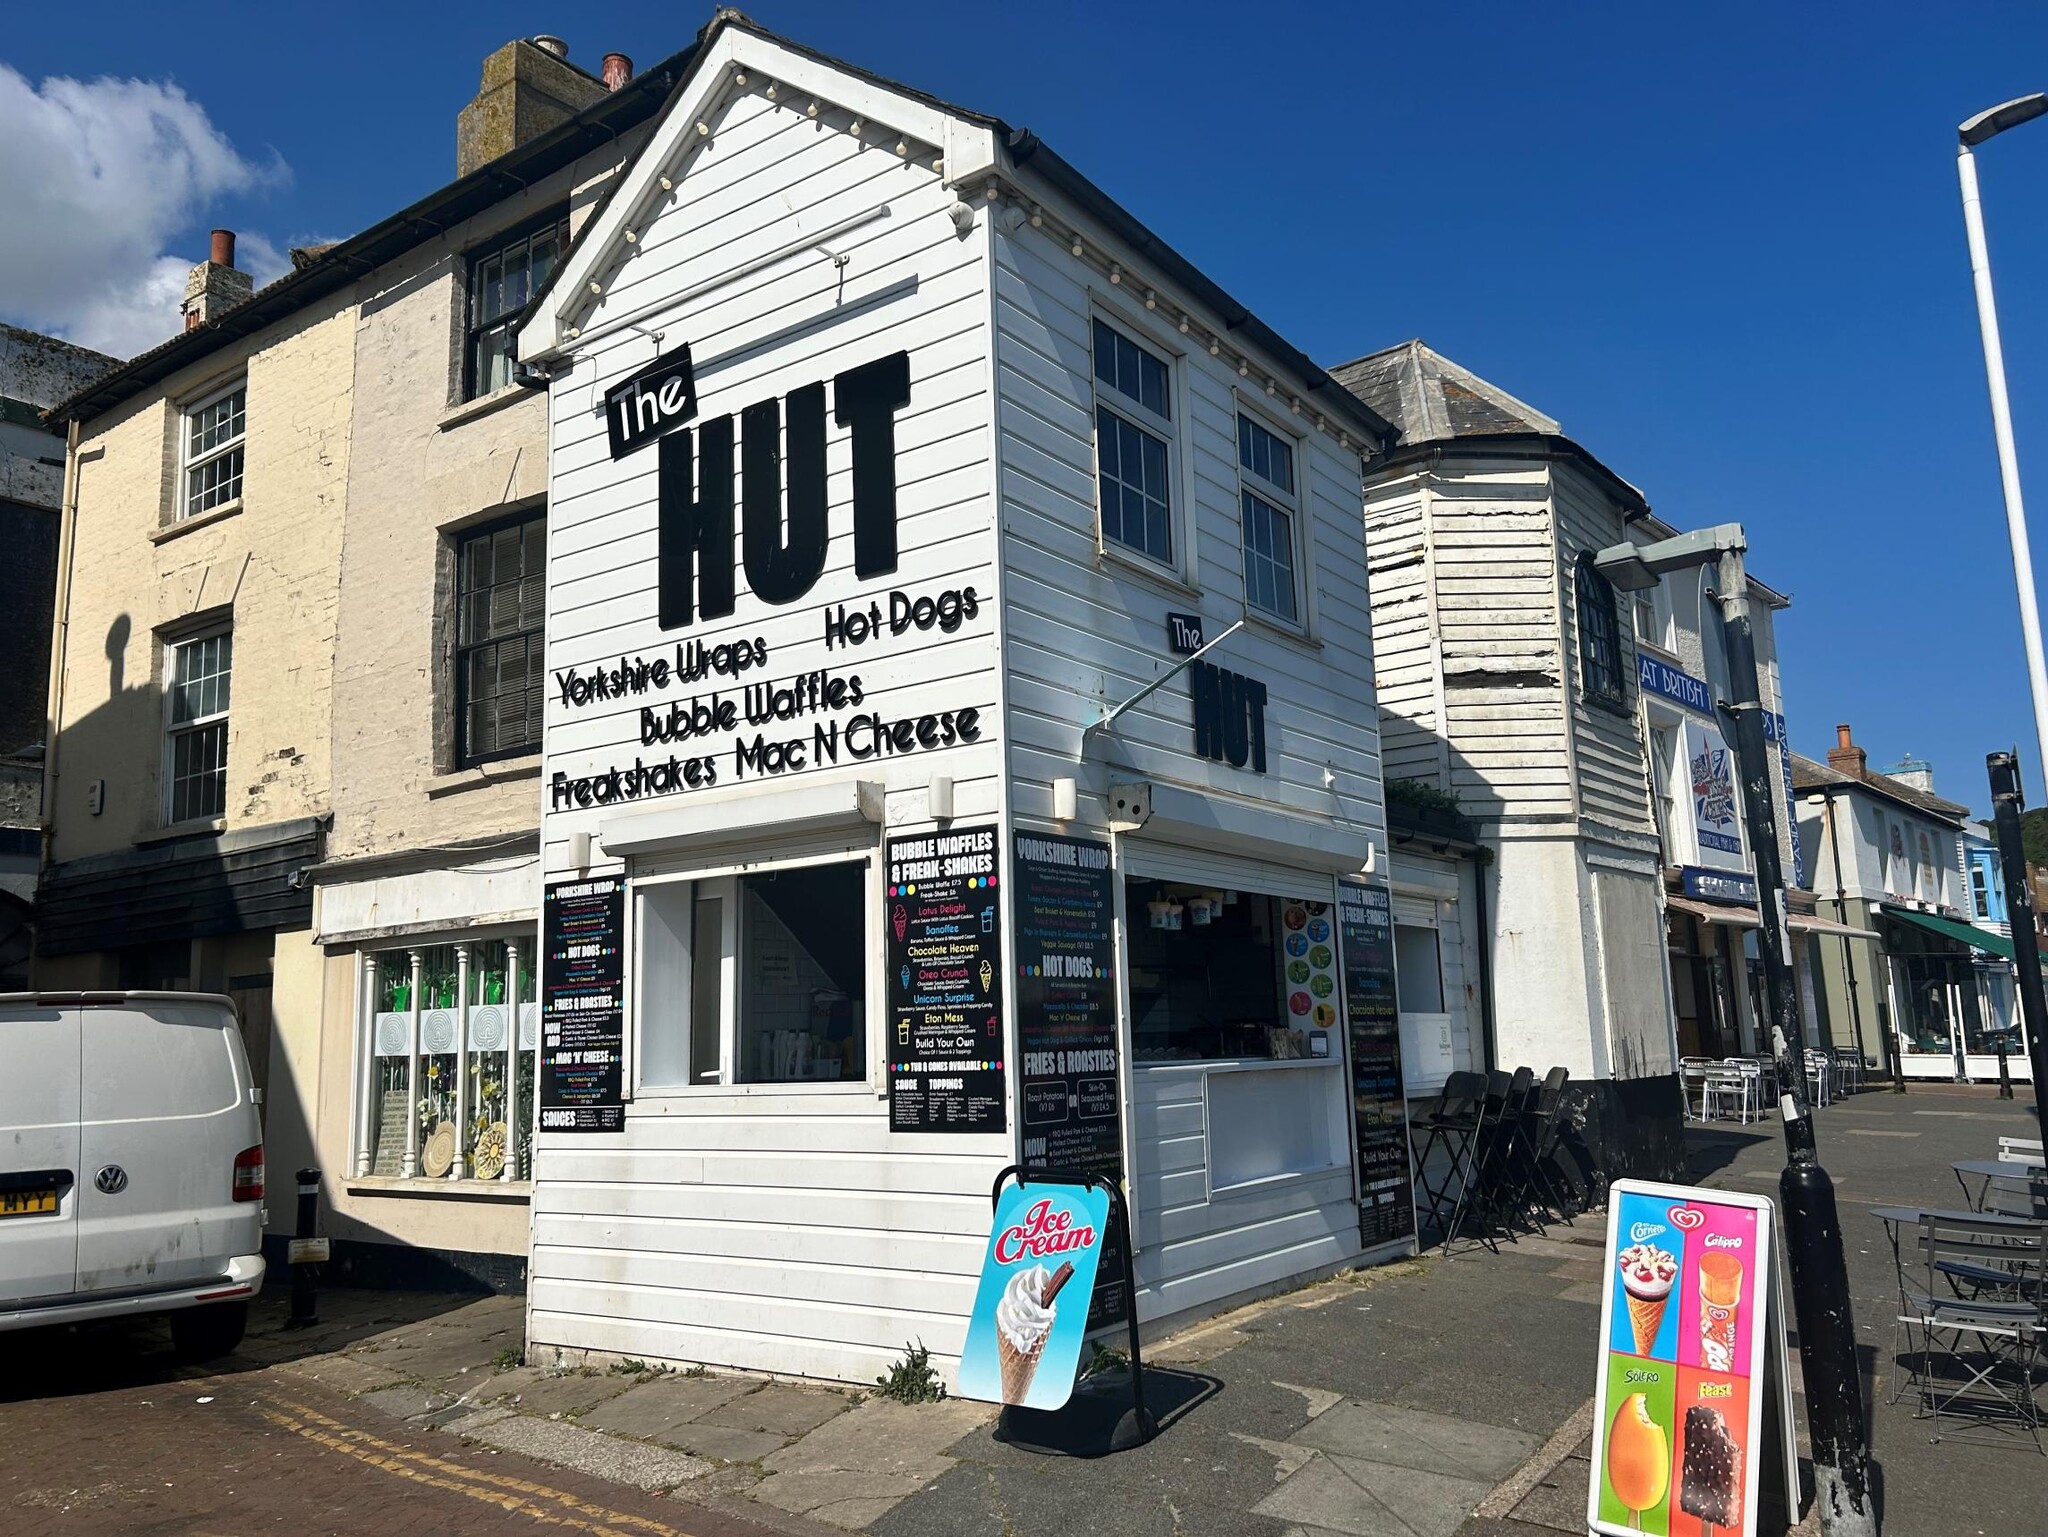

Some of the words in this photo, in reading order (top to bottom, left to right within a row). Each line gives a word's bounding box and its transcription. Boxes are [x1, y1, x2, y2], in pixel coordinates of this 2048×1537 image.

[611, 375, 687, 443] The
[658, 350, 911, 631] HUT
[825, 601, 882, 650] Hot
[889, 585, 978, 635] Dogs
[1172, 616, 1202, 650] The
[556, 656, 670, 707] Yorkshire
[676, 636, 767, 682] Wraps
[1662, 668, 1704, 707] BRITISH
[640, 692, 737, 746] Bubble
[745, 669, 863, 725] Waffles
[1192, 657, 1266, 773] HUT
[552, 753, 717, 810] Freakshakes
[736, 732, 807, 777] Mac
[814, 719, 837, 765] N
[845, 706, 981, 758] Cheese
[891, 838, 935, 861] BUBBLE
[937, 832, 993, 856] WAFFLES
[1017, 838, 1076, 866] YORKSHIRE
[1077, 848, 1108, 869] WRAP
[892, 864, 900, 883] &
[902, 853, 993, 881] FREAK-SHAKES
[556, 884, 593, 899] YORKSHIRE
[594, 881, 614, 894] WRAP
[918, 882, 934, 890] Bubble
[936, 880, 950, 888] Waffle
[1339, 886, 1361, 902] BUBBLE
[1362, 889, 1388, 908] WAFFLES
[918, 906, 938, 916] Lotus
[940, 903, 966, 914] Delight
[926, 924, 959, 935] Banoffee
[568, 946, 580, 959] HOT
[581, 944, 600, 958] DOGS
[908, 945, 948, 957] Chocolate
[950, 944, 979, 953] Heaven
[919, 970, 938, 980] Oreo
[941, 968, 968, 978] Crunch
[1042, 955, 1064, 977] HOT
[1065, 956, 1092, 978] DOGS
[555, 998, 573, 1011] FRIES
[580, 996, 612, 1009] ROASTIES
[914, 994, 942, 1004] Unicorn
[944, 992, 974, 1003] Surprise
[925, 1014, 942, 1023] Eton
[944, 1012, 963, 1022] Mess
[1349, 1004, 1374, 1015] Chocolate
[1376, 1005, 1394, 1016] Heaven
[545, 1022, 560, 1034] NOW
[547, 1036, 560, 1047] ADD
[916, 1038, 934, 1048] Build
[936, 1038, 954, 1048] Your
[956, 1036, 974, 1047] Own
[556, 1052, 571, 1064] MAC
[583, 1050, 609, 1063] CHEESE
[1024, 1052, 1055, 1076] FRIES
[1057, 1052, 1065, 1075] &
[1067, 1050, 1115, 1073] ROASTIES
[949, 1060, 981, 1071] AVAILABLE
[895, 1079, 917, 1090] SAUCE
[929, 1078, 963, 1090] TOPPINGS
[1089, 1083, 1107, 1092] Skin-On
[1027, 1094, 1042, 1102] Roast
[1043, 1092, 1065, 1100] Potatoes
[1069, 1094, 1077, 1107] OR
[1081, 1094, 1103, 1102] Seasoned
[1104, 1092, 1115, 1100] Fries
[1039, 1104, 1047, 1112] (V)
[1091, 1104, 1099, 1112] (V)
[543, 1111, 576, 1127] SAUCES
[1367, 1114, 1379, 1125] Eton
[1025, 1137, 1046, 1157] NOW
[1364, 1152, 1377, 1164] Build
[1378, 1150, 1389, 1162] Your
[4, 1192, 48, 1212] MYY
[1024, 1199, 1073, 1238] Ice
[1631, 1222, 1666, 1242] Cornetto
[994, 1225, 1097, 1265] Cream
[1704, 1233, 1742, 1248] Calippo
[1698, 1382, 1732, 1399] Feast
